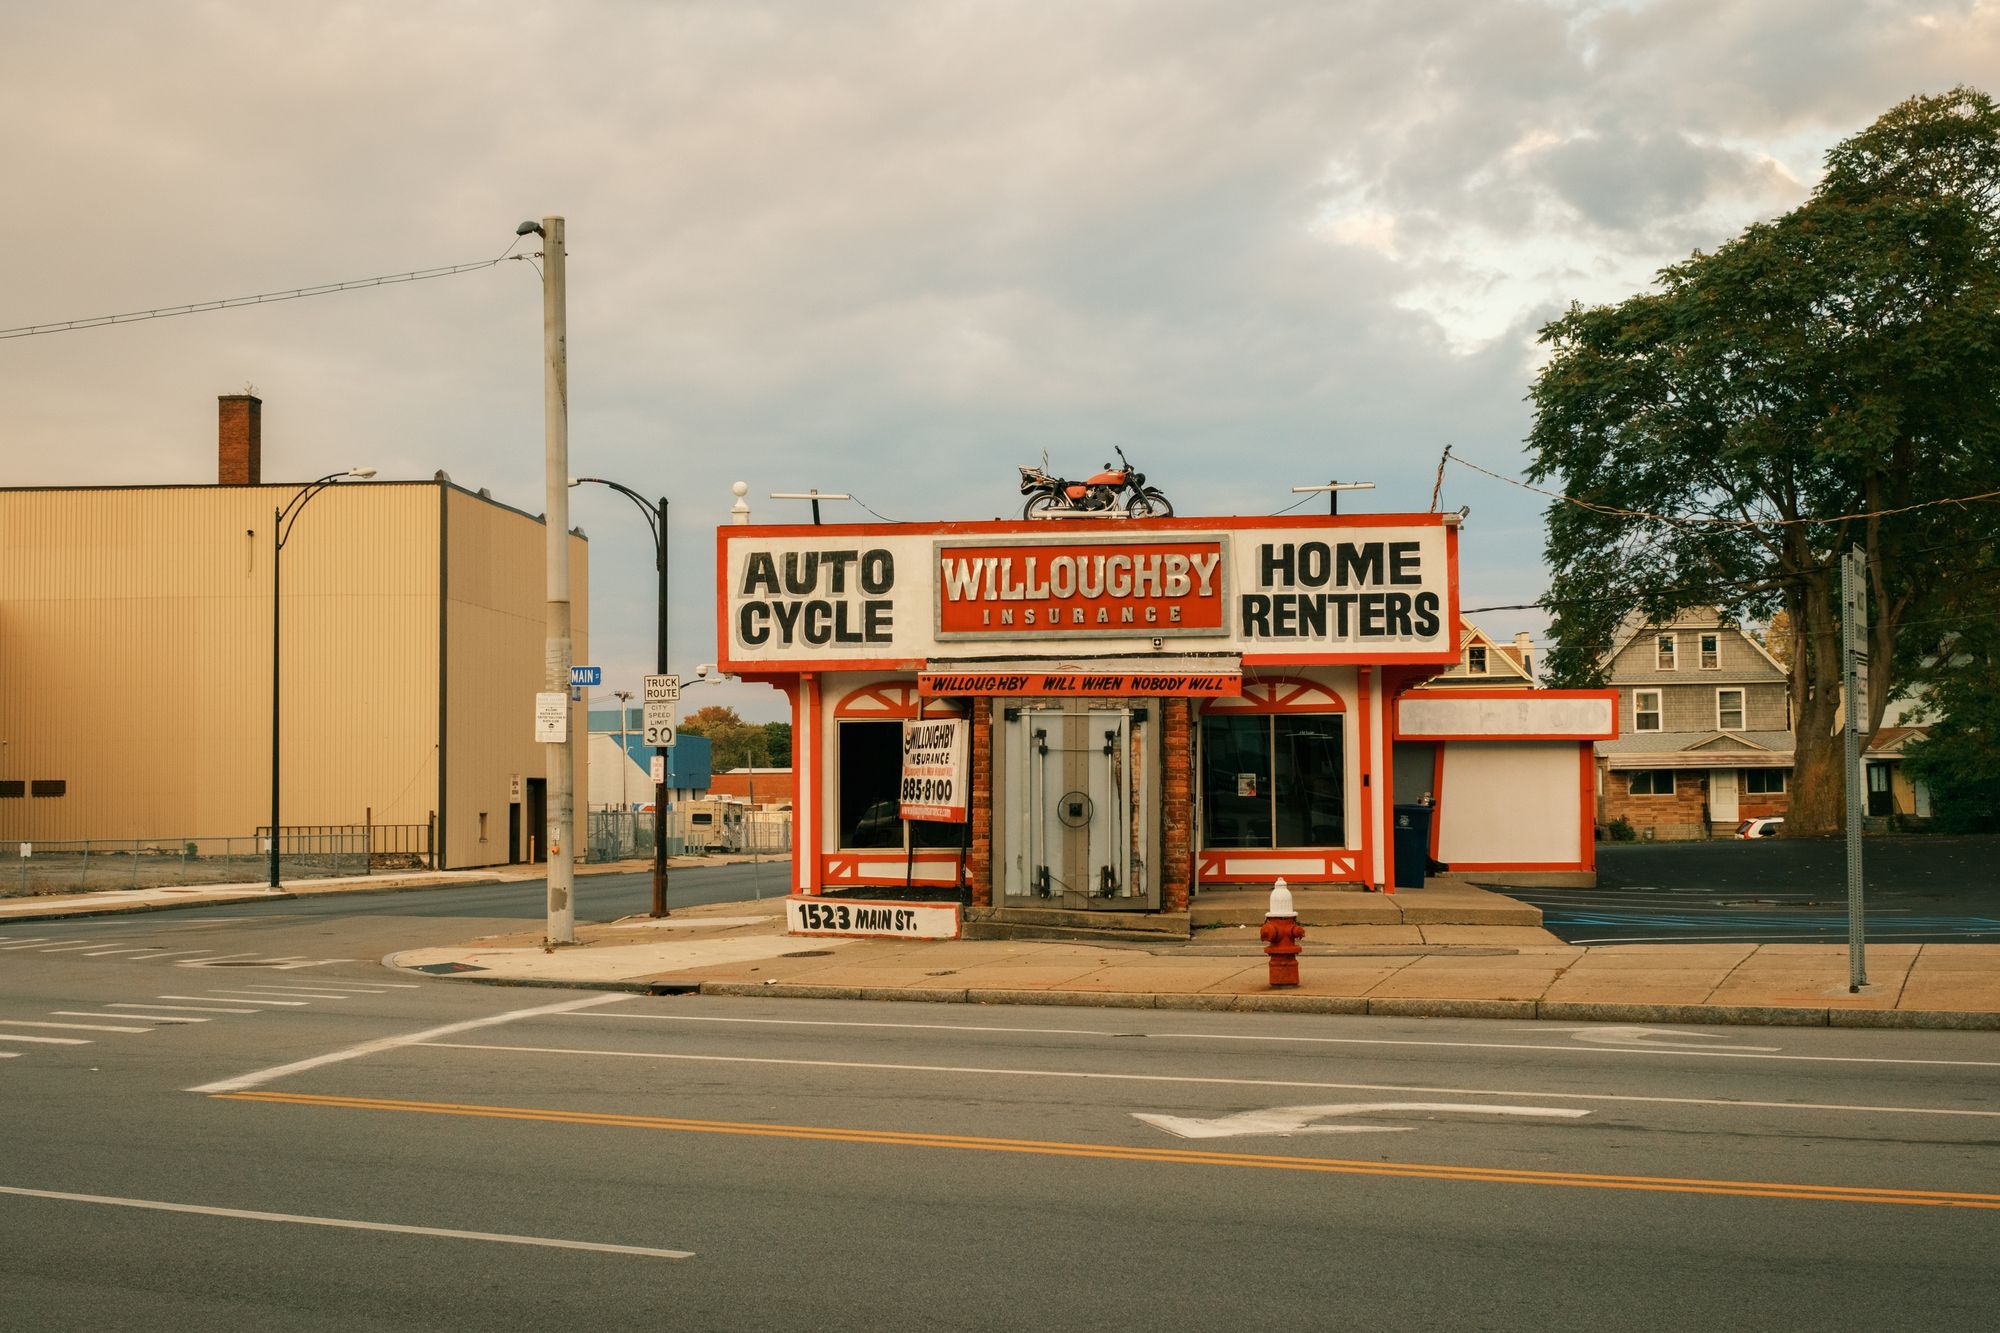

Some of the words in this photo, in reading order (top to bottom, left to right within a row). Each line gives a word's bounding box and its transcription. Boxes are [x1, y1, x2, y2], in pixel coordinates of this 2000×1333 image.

[739, 549, 895, 599] AUTO
[941, 552, 1220, 602] WILLOUGHBY
[1256, 541, 1422, 591] HOME
[736, 600, 893, 649] CYCLE
[983, 605, 1182, 625] INSURANCE
[1238, 591, 1440, 642] RENTERS
[571, 669, 594, 683] MAIN
[647, 678, 677, 688] TRUCK
[1042, 676, 1076, 691] WILL
[1081, 676, 1123, 691] WHEN
[1130, 677, 1187, 692] NOBODY
[647, 688, 677, 698] ROUTE
[647, 727, 672, 743] 30
[908, 723, 955, 751] WILLOUGHBY
[909, 752, 950, 765] INSURANCE
[799, 904, 851, 930] 1523
[855, 908, 892, 931] MAIN
[895, 909, 917, 931] ST.
